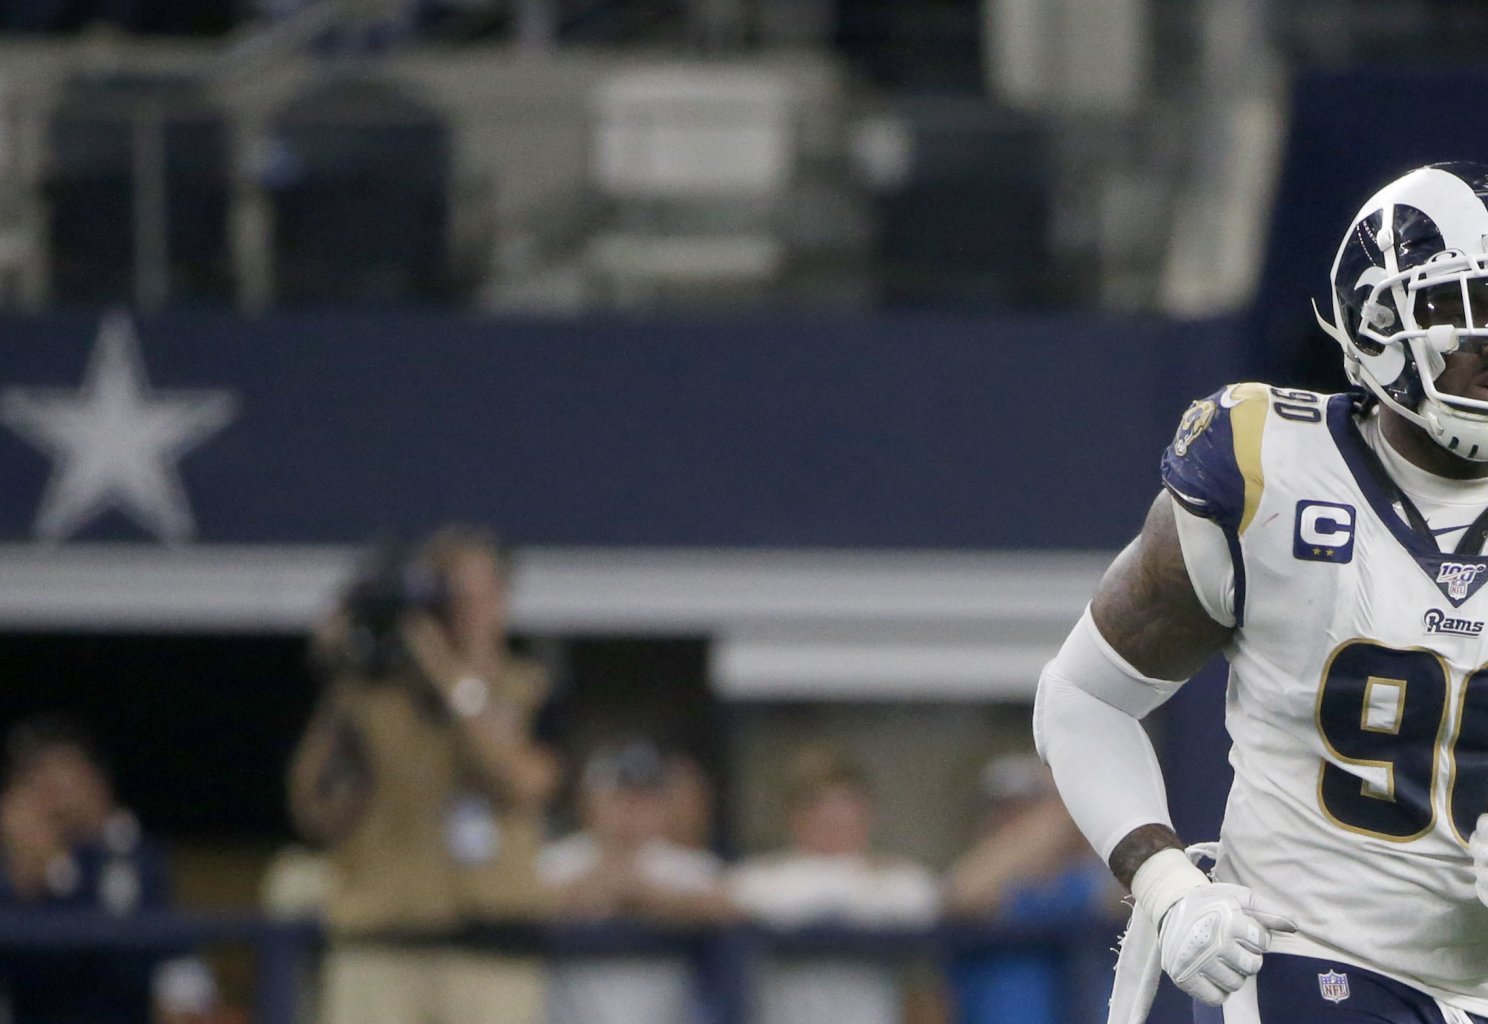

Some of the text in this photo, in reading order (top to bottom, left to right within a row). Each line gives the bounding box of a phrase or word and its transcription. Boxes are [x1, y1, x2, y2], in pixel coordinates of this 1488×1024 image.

[1300, 505, 1352, 547] C
[1424, 608, 1485, 635] Rams
[1324, 984, 1347, 997] NFL
